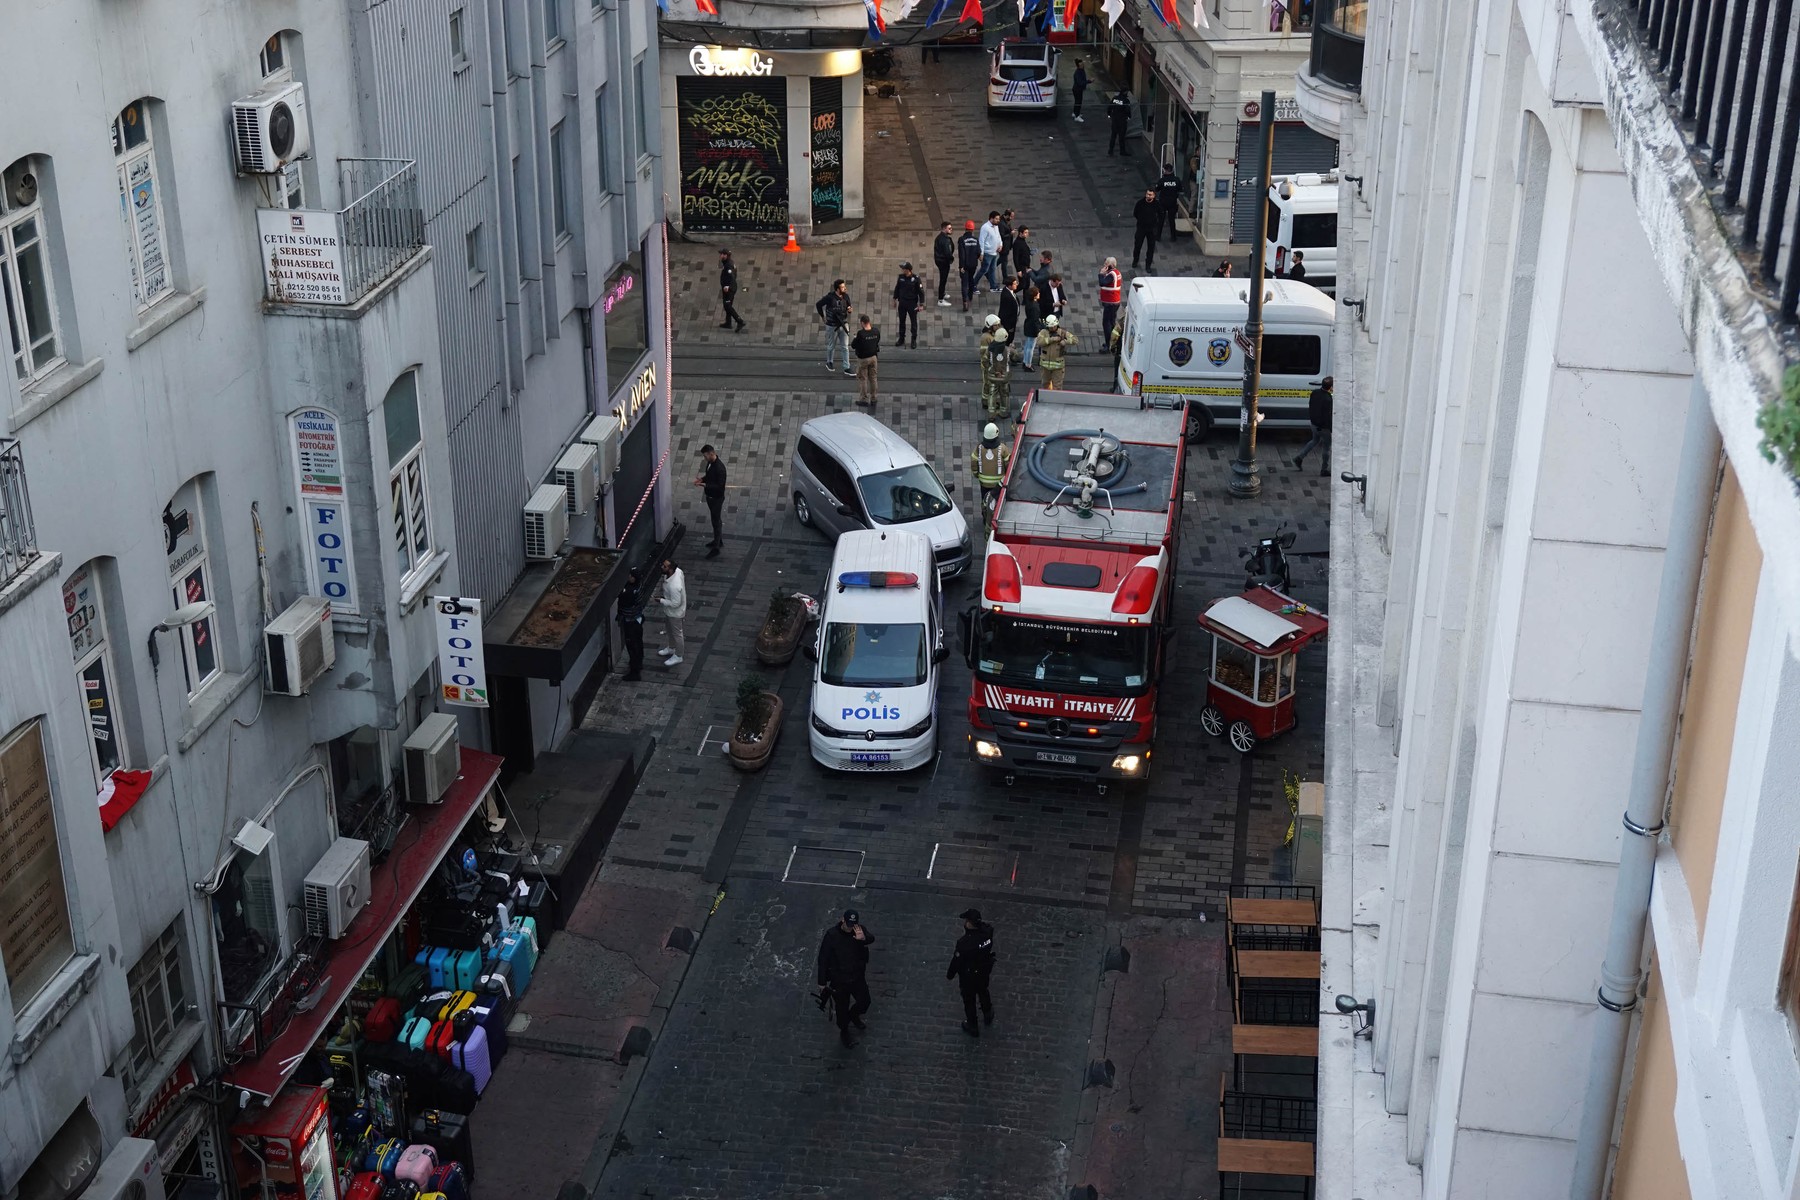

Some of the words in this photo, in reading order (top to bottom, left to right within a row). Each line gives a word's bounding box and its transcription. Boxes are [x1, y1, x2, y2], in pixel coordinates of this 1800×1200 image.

[689, 45, 774, 76] Bambi
[264, 234, 296, 244] ÇETİN
[299, 235, 337, 246] SÜMER
[279, 247, 323, 256] SERBEST
[271, 258, 334, 270] MUHASEBECİ
[269, 270, 294, 279] MALİ
[296, 271, 340, 282] MÜŞAVİR
[307, 284, 320, 292] 520
[333, 294, 342, 302] 18
[630, 361, 656, 416] AVIEN
[304, 412, 326, 420] ACELE
[298, 421, 334, 431] VESİKALIK
[299, 432, 335, 441] BİYOMETRİK
[300, 442, 336, 450] FOTOĞRAF
[316, 508, 346, 598] FOTO
[448, 618, 476, 686] FOTO
[842, 705, 900, 720] POLİS
[1064, 699, 1114, 714] İTFAİYE
[94, 729, 108, 738] SONY
